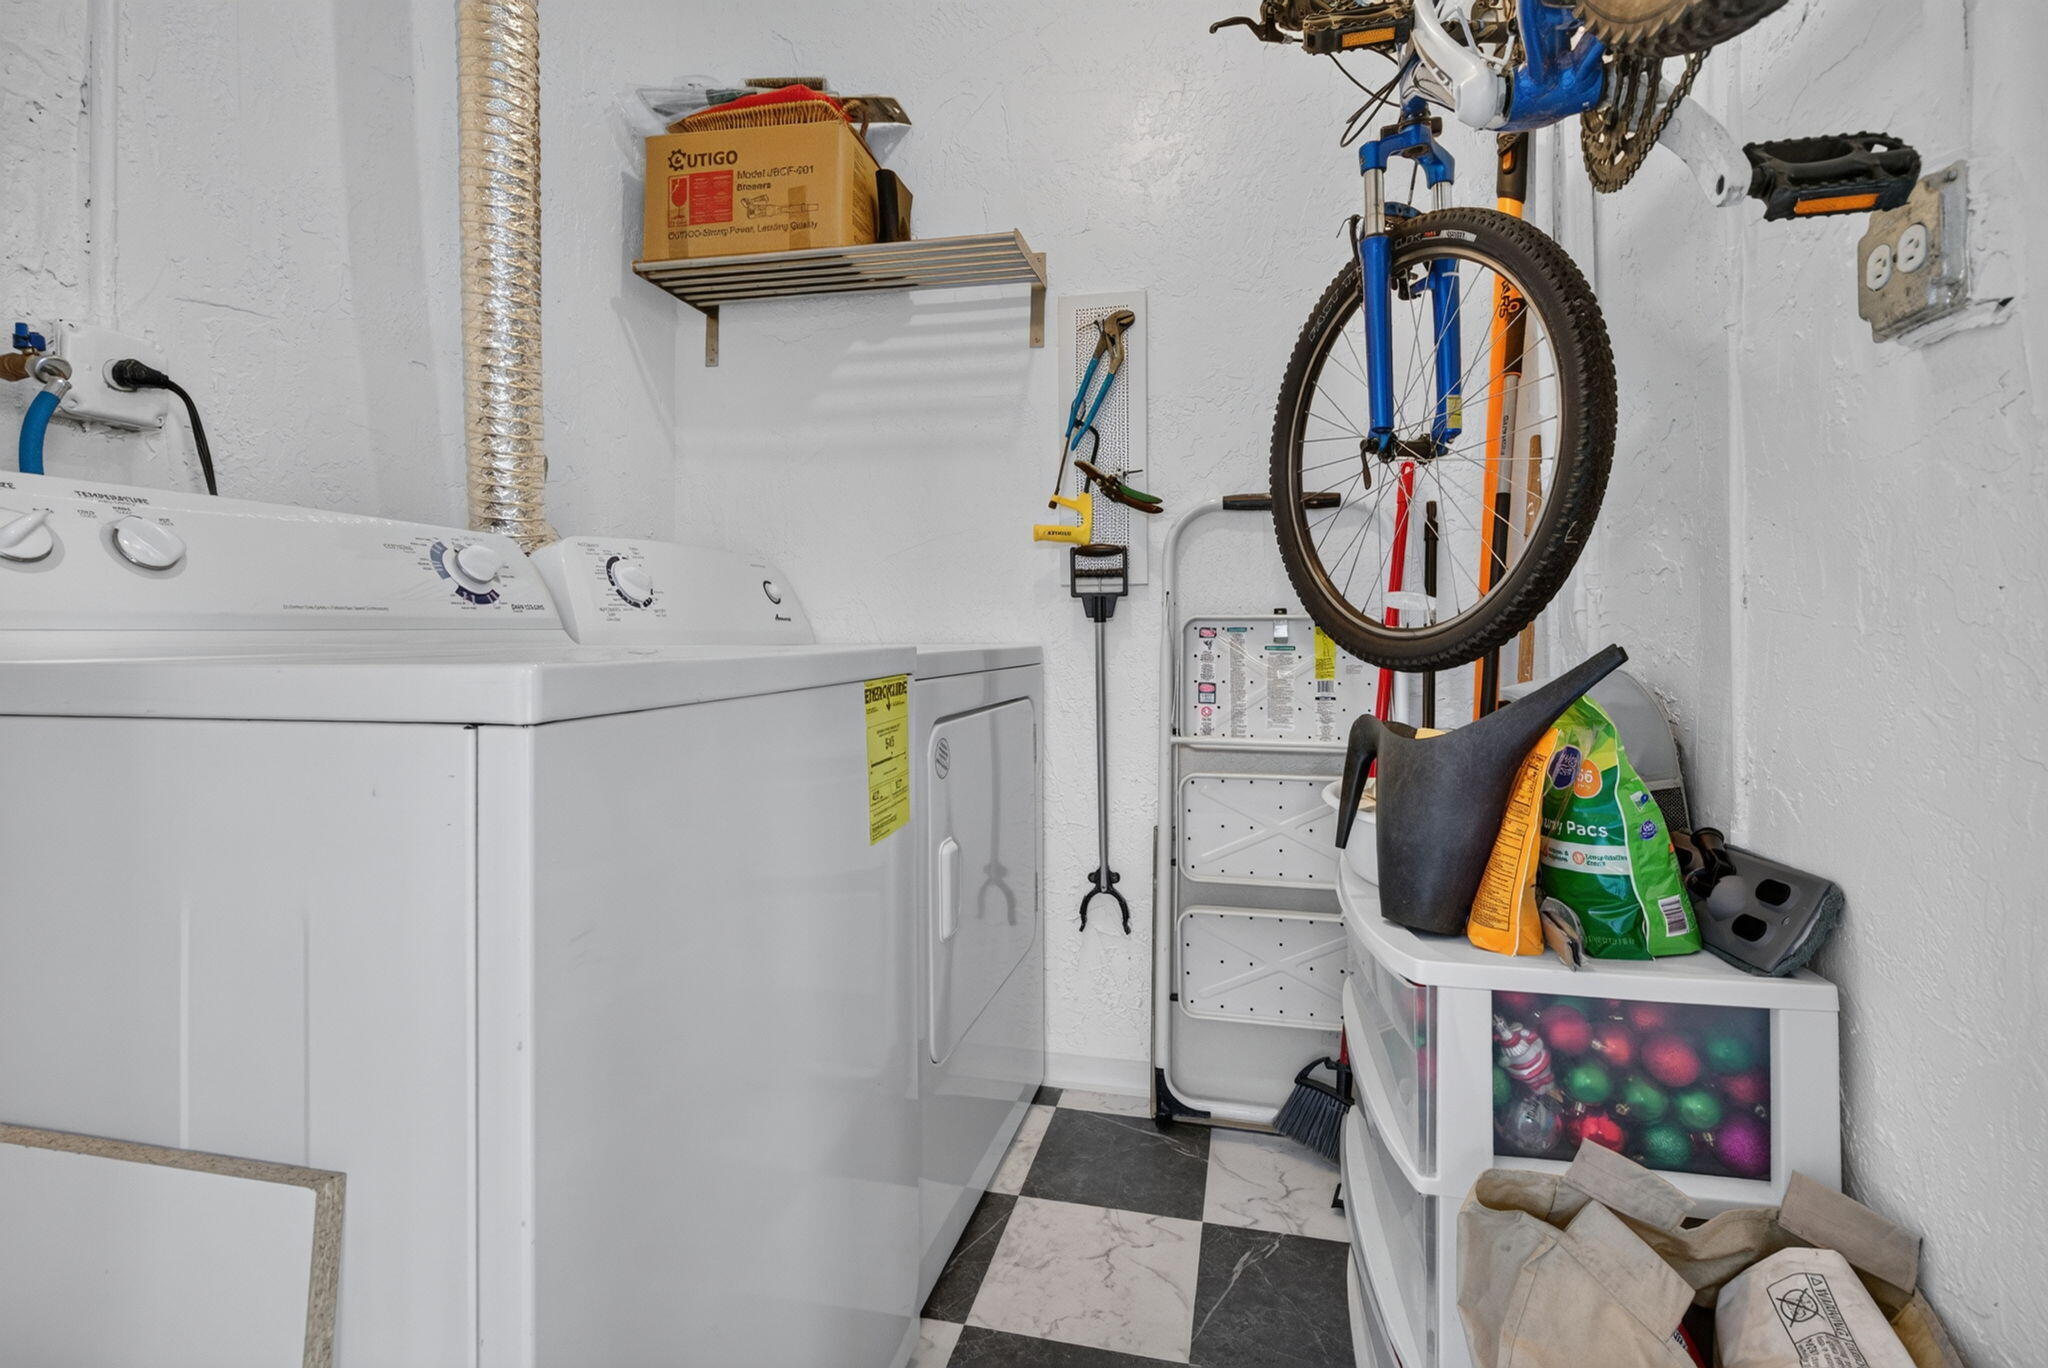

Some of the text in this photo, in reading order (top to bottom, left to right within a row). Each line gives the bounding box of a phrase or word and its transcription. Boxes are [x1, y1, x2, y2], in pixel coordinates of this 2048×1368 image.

[737, 168, 765, 180] Model
[73, 489, 150, 506] TEMPERATURE
[1566, 820, 1608, 838] Pacs
[1814, 1288, 1850, 1339] WARNING
